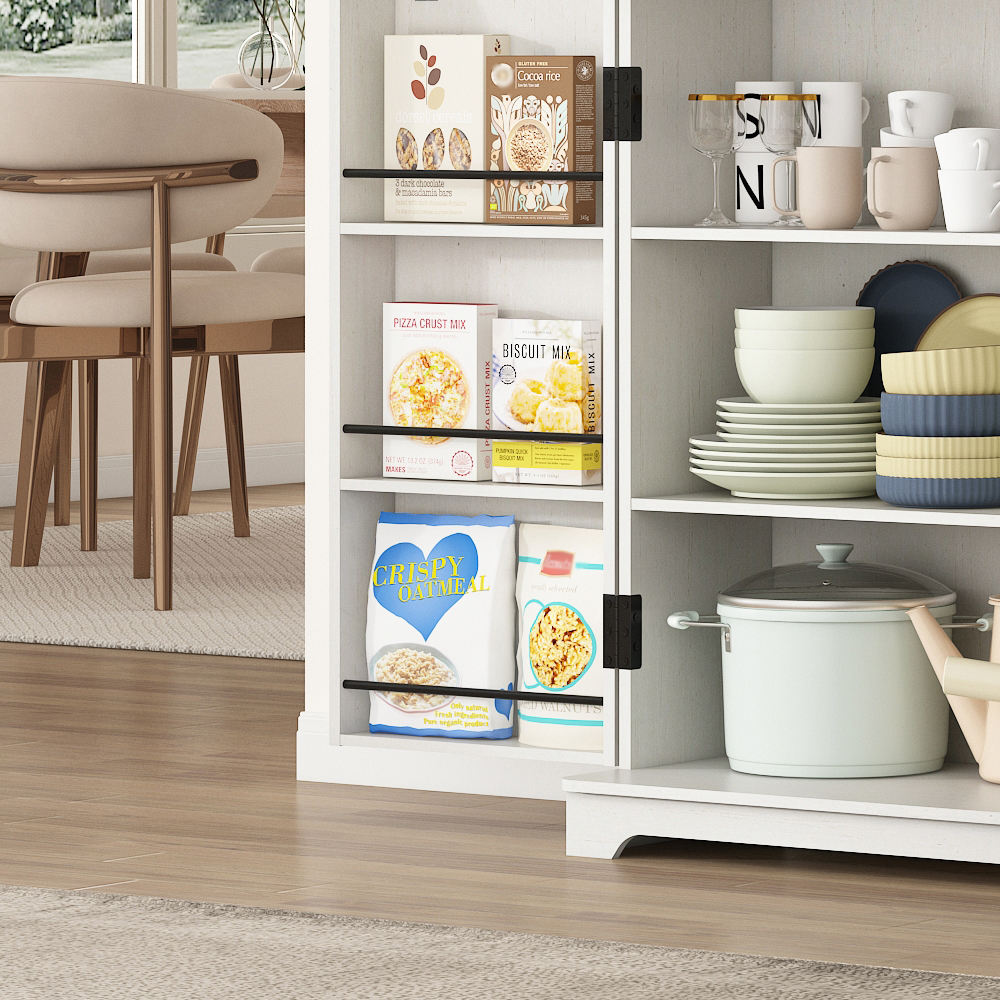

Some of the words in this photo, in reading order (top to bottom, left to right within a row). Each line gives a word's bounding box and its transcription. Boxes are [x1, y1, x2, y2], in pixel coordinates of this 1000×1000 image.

[517, 70, 544, 81] Cocoa
[545, 70, 561, 81] rice
[395, 109, 431, 123] dorset
[432, 109, 473, 123] cereals
[736, 93, 765, 139] S
[400, 178, 416, 188] dark
[416, 179, 445, 188] chocolate
[736, 164, 765, 210] N
[394, 187, 401, 197] &
[401, 187, 438, 197] macadamia
[438, 188, 453, 197] bars
[393, 317, 417, 328] PIZZA
[419, 318, 448, 329] CRUST
[450, 319, 466, 329] MIX
[503, 343, 546, 359] BISCUIT
[552, 345, 571, 360] MIX
[588, 382, 596, 433] BISCUIT
[495, 447, 514, 455] PUMPKIN
[385, 465, 406, 473] MAKES
[372, 555, 465, 587] CRISPY
[397, 574, 491, 603] OATMEAL
[450, 702, 465, 711] Only
[465, 704, 489, 713] natural
[539, 701, 602, 714] WALNUTS
[434, 710, 453, 719] Fresh
[453, 711, 489, 720] ingredients
[423, 717, 438, 725] Pure
[439, 718, 463, 727] organic
[463, 719, 489, 728] product
